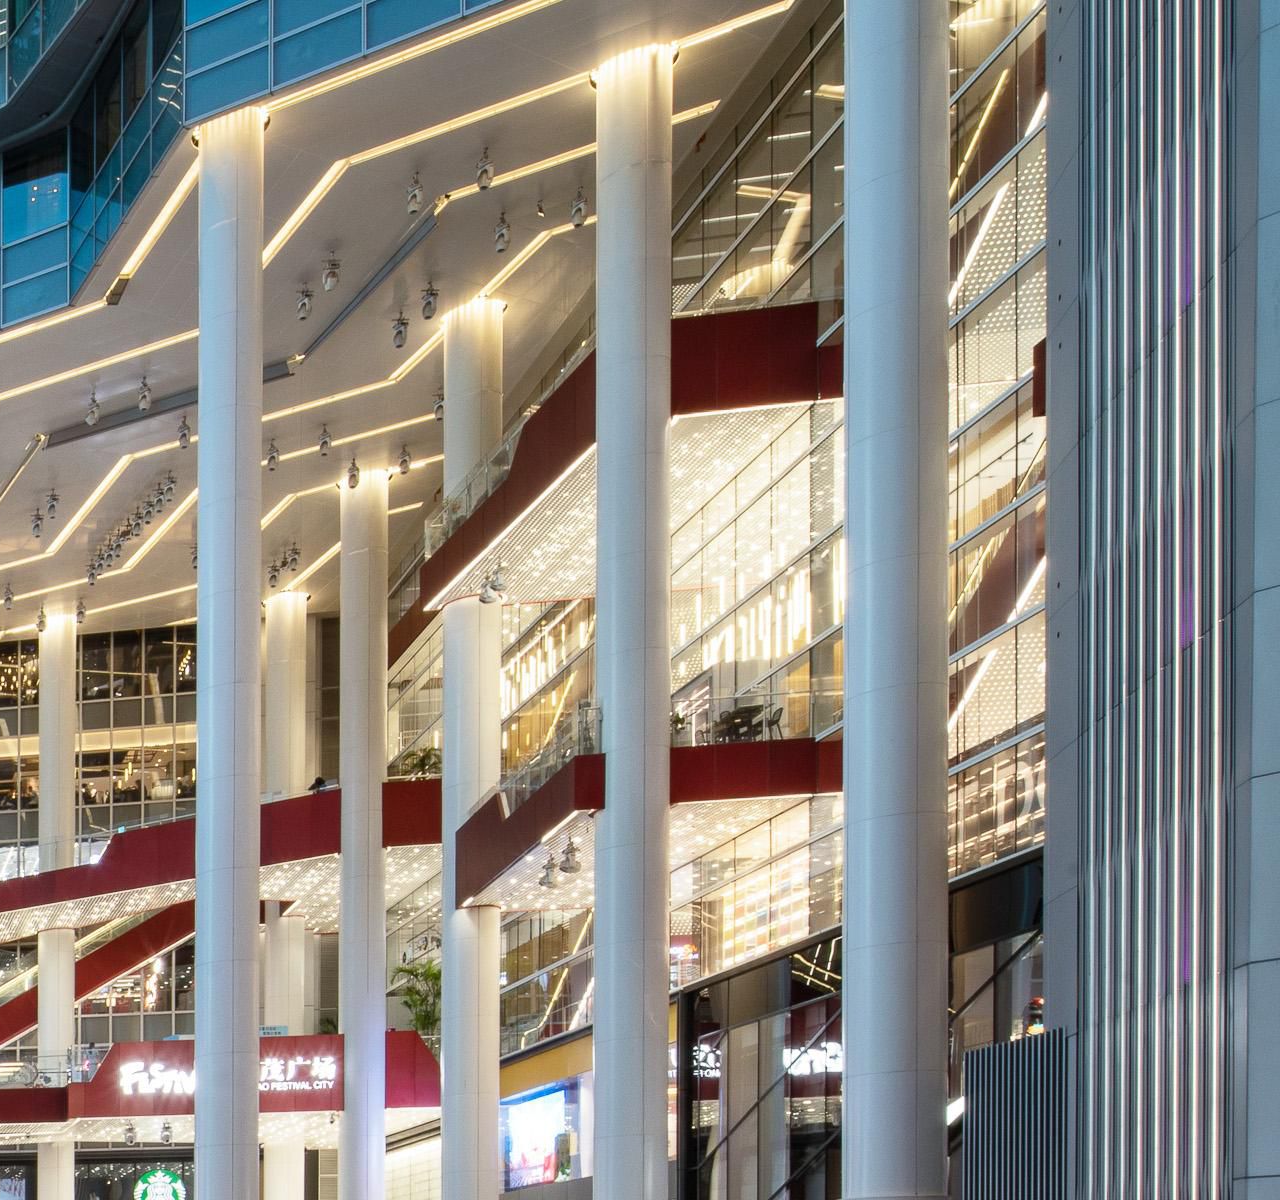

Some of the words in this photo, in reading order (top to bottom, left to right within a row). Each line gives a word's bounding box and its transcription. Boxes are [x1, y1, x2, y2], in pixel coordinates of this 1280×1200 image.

[259, 1056, 337, 1082] 茂广场
[270, 1081, 312, 1091] FESTIVAL
[313, 1079, 335, 1090] CITY
